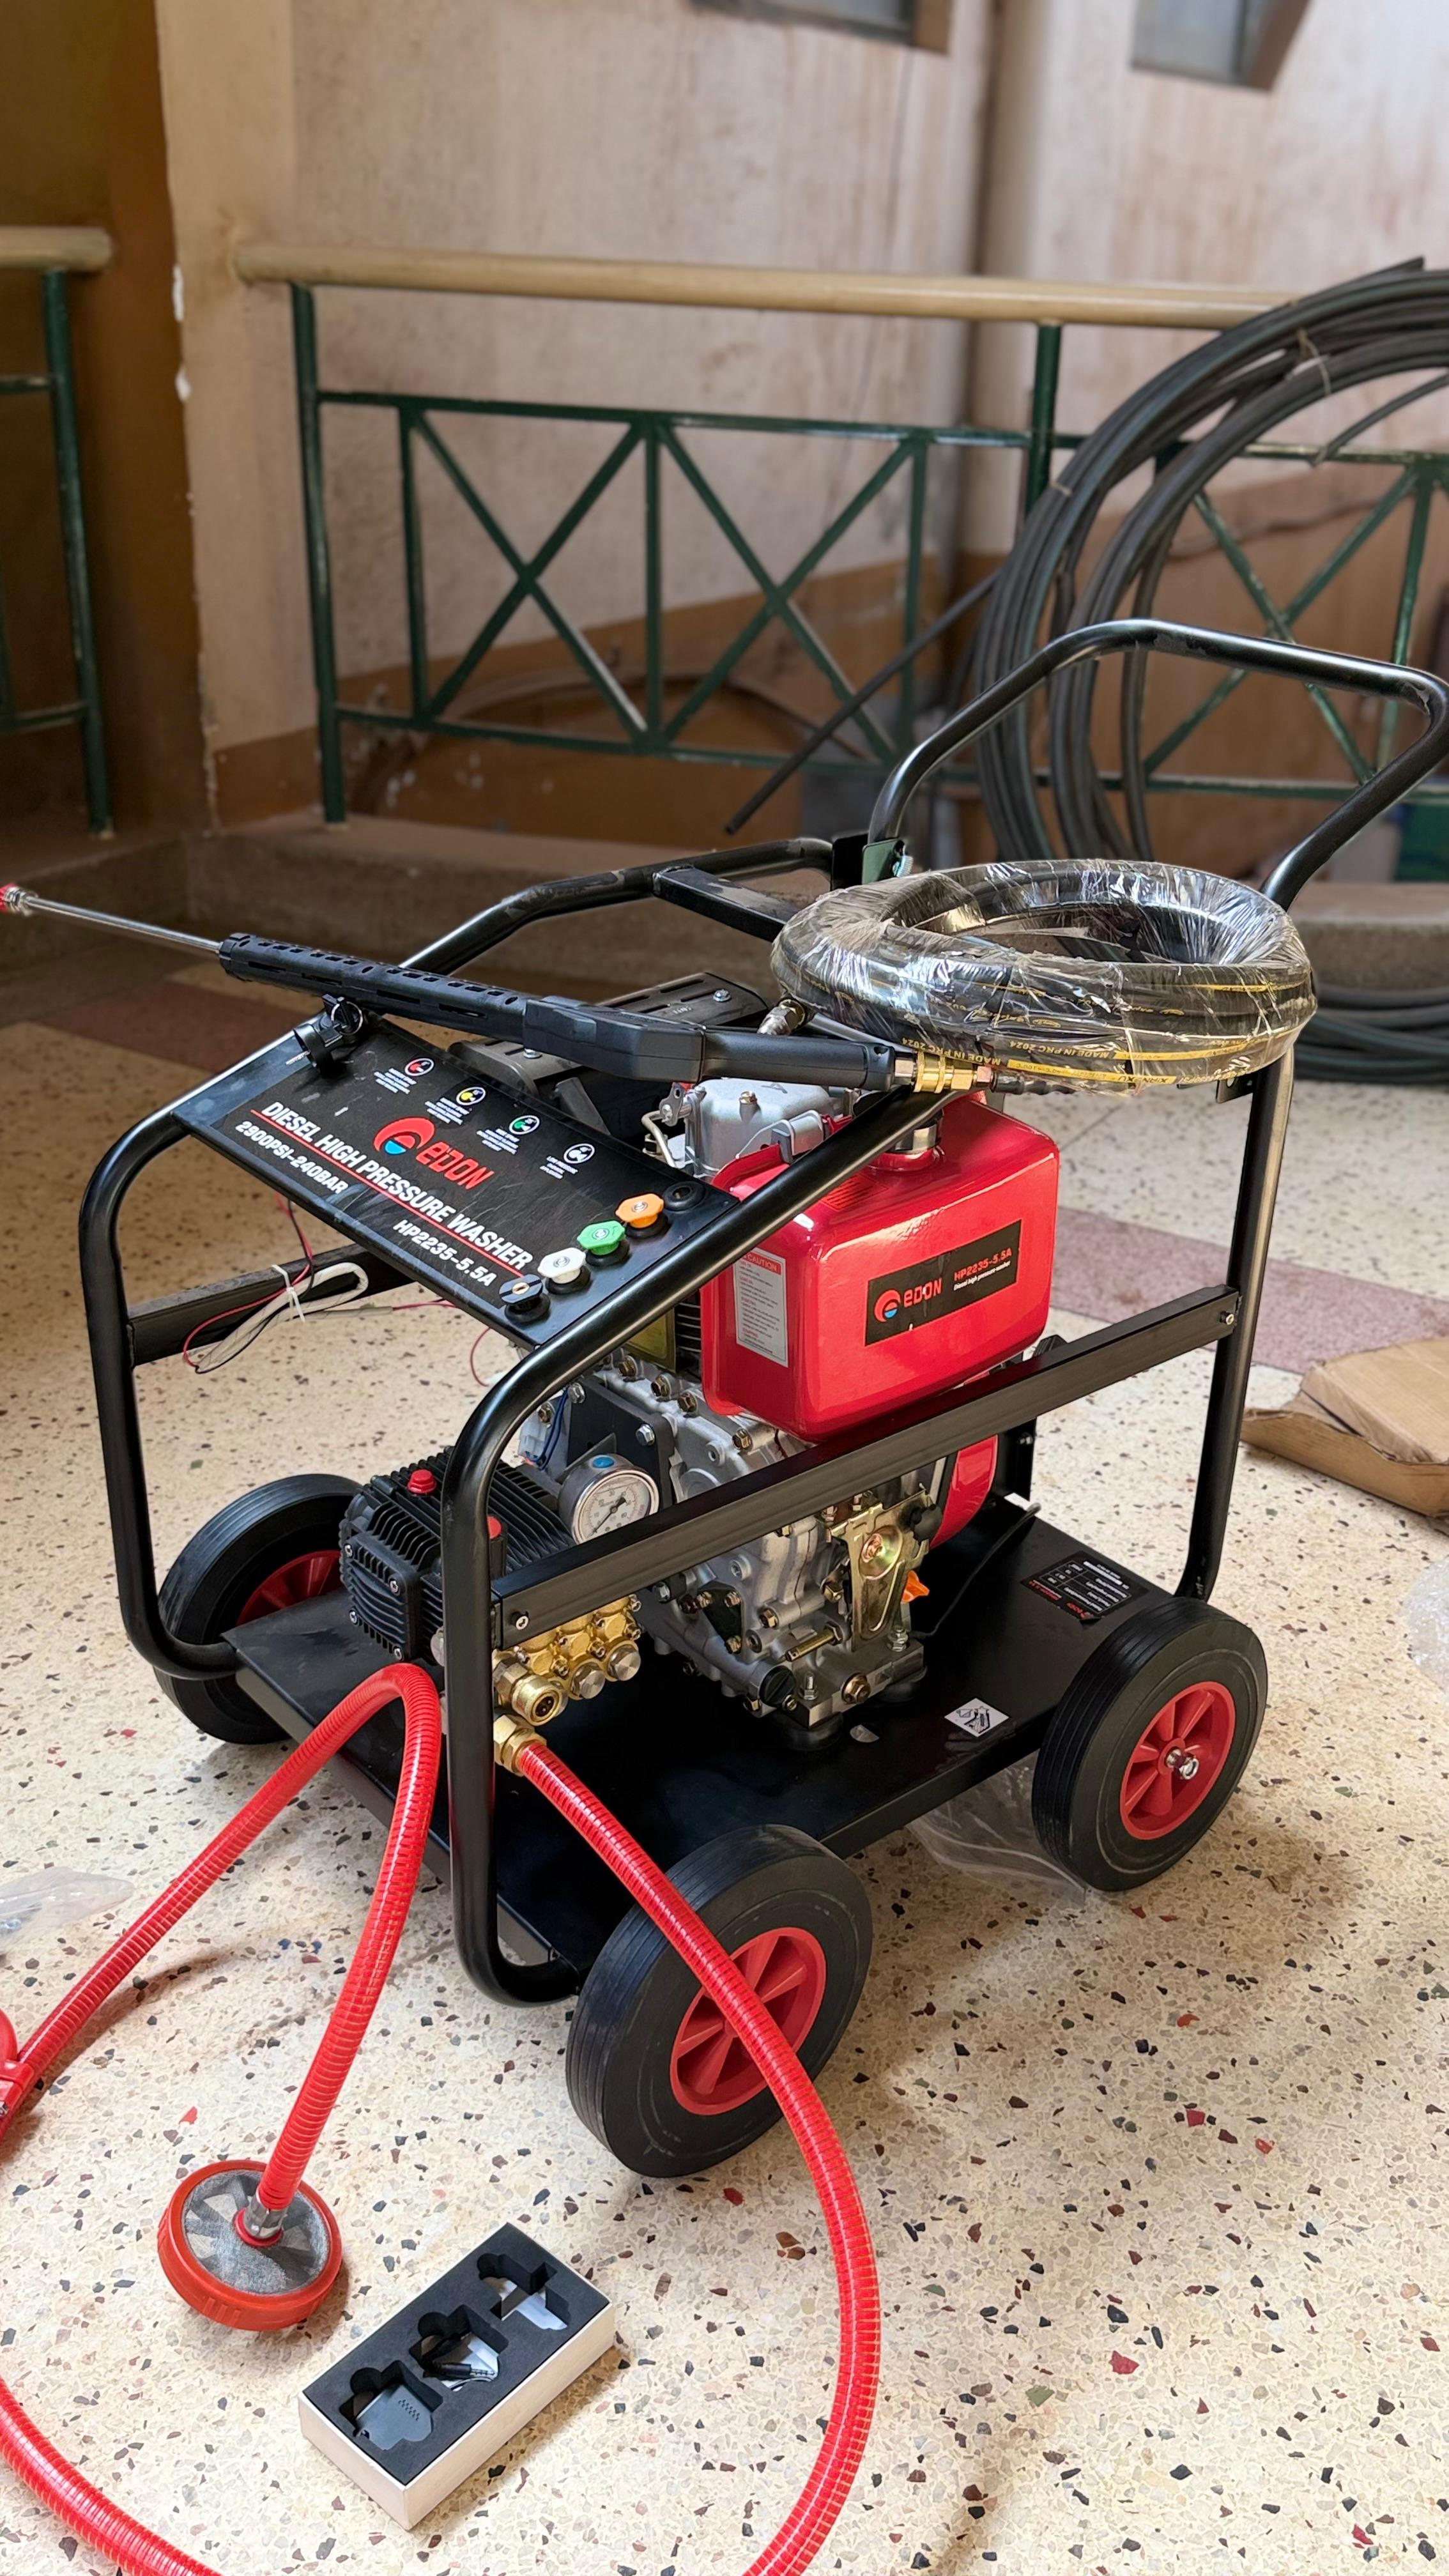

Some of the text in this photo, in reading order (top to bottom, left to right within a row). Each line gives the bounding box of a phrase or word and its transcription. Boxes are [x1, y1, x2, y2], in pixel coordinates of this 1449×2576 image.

[902, 1037, 1001, 1066] MADE IN PRC 2024
[1009, 1040, 1035, 1050] 2024
[1038, 1044, 1061, 1055] PRC
[1063, 1048, 1077, 1056] IN
[1077, 1049, 1109, 1059] MADE
[235, 1121, 348, 1194] 2900PSI-240BAR
[261, 1101, 533, 1270] DIESEL HIGH PRESSURE WASHER
[393, 1220, 496, 1286] HP2235-5.5A
[954, 1247, 1012, 1281] HP2235-5.5A
